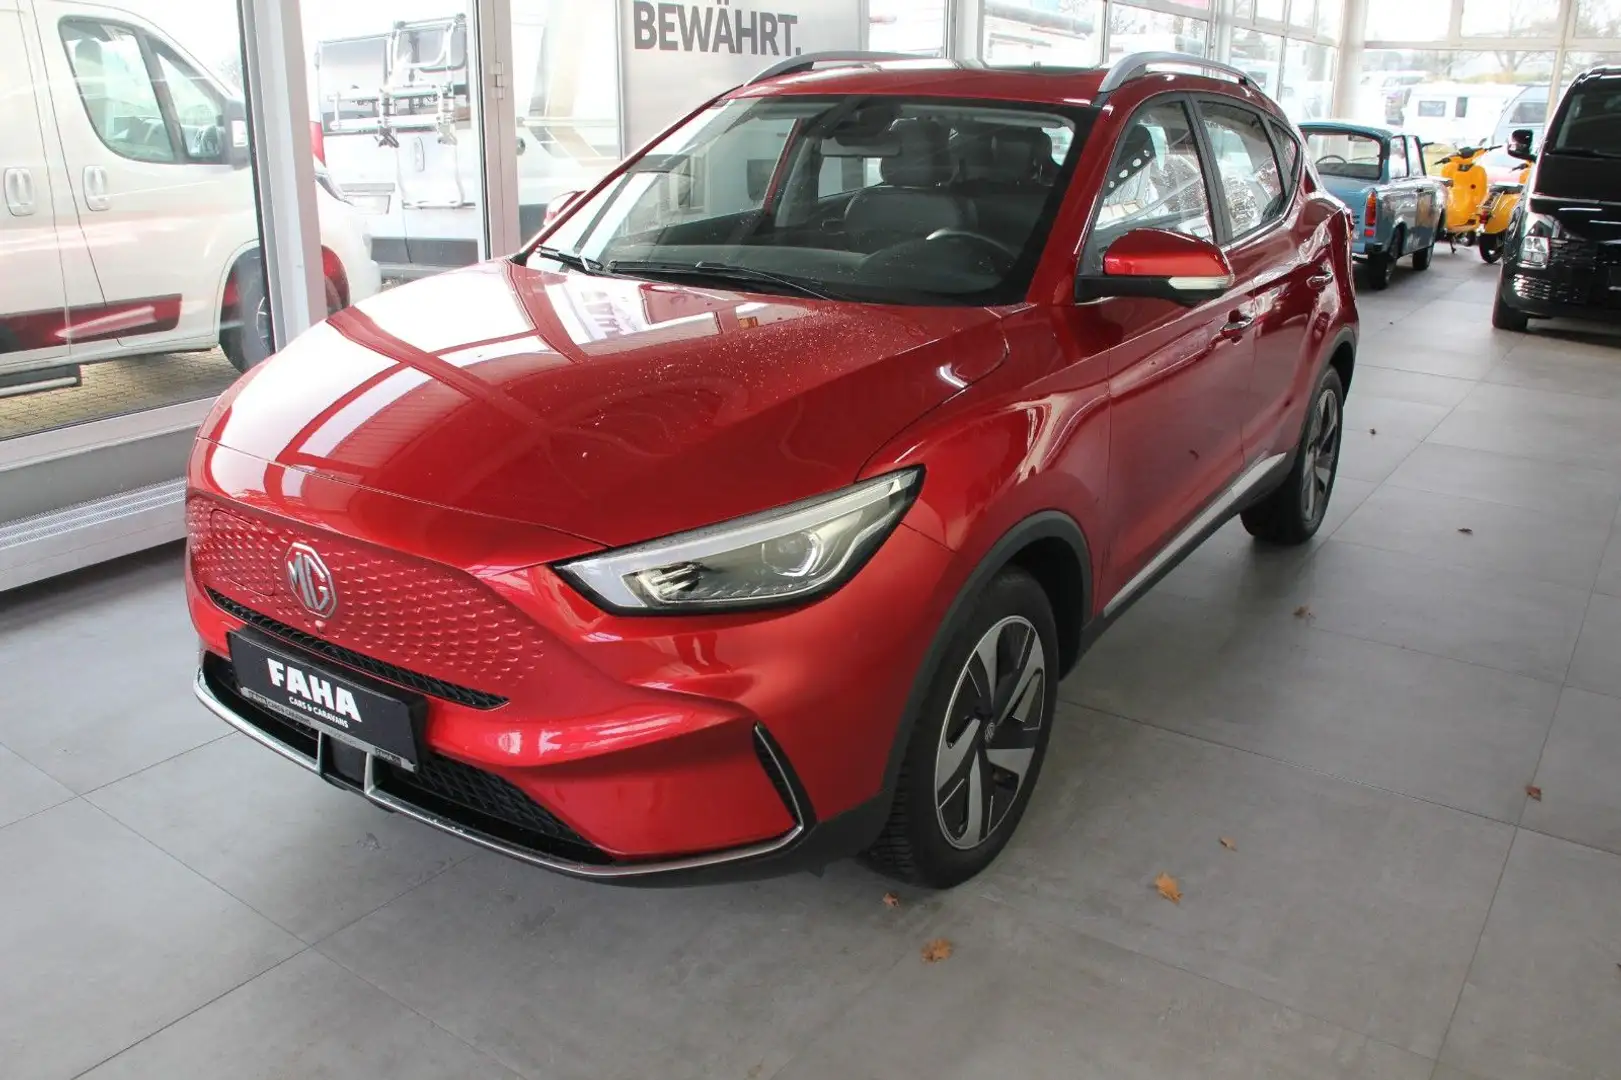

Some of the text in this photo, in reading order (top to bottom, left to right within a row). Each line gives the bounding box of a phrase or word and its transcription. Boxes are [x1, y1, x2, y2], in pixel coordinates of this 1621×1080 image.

[634, 0, 801, 57] BEWÄHRT.
[287, 552, 330, 611] MG
[267, 657, 362, 722] FAHA
[288, 695, 307, 710] CARS
[312, 706, 349, 728] CARAVANS
